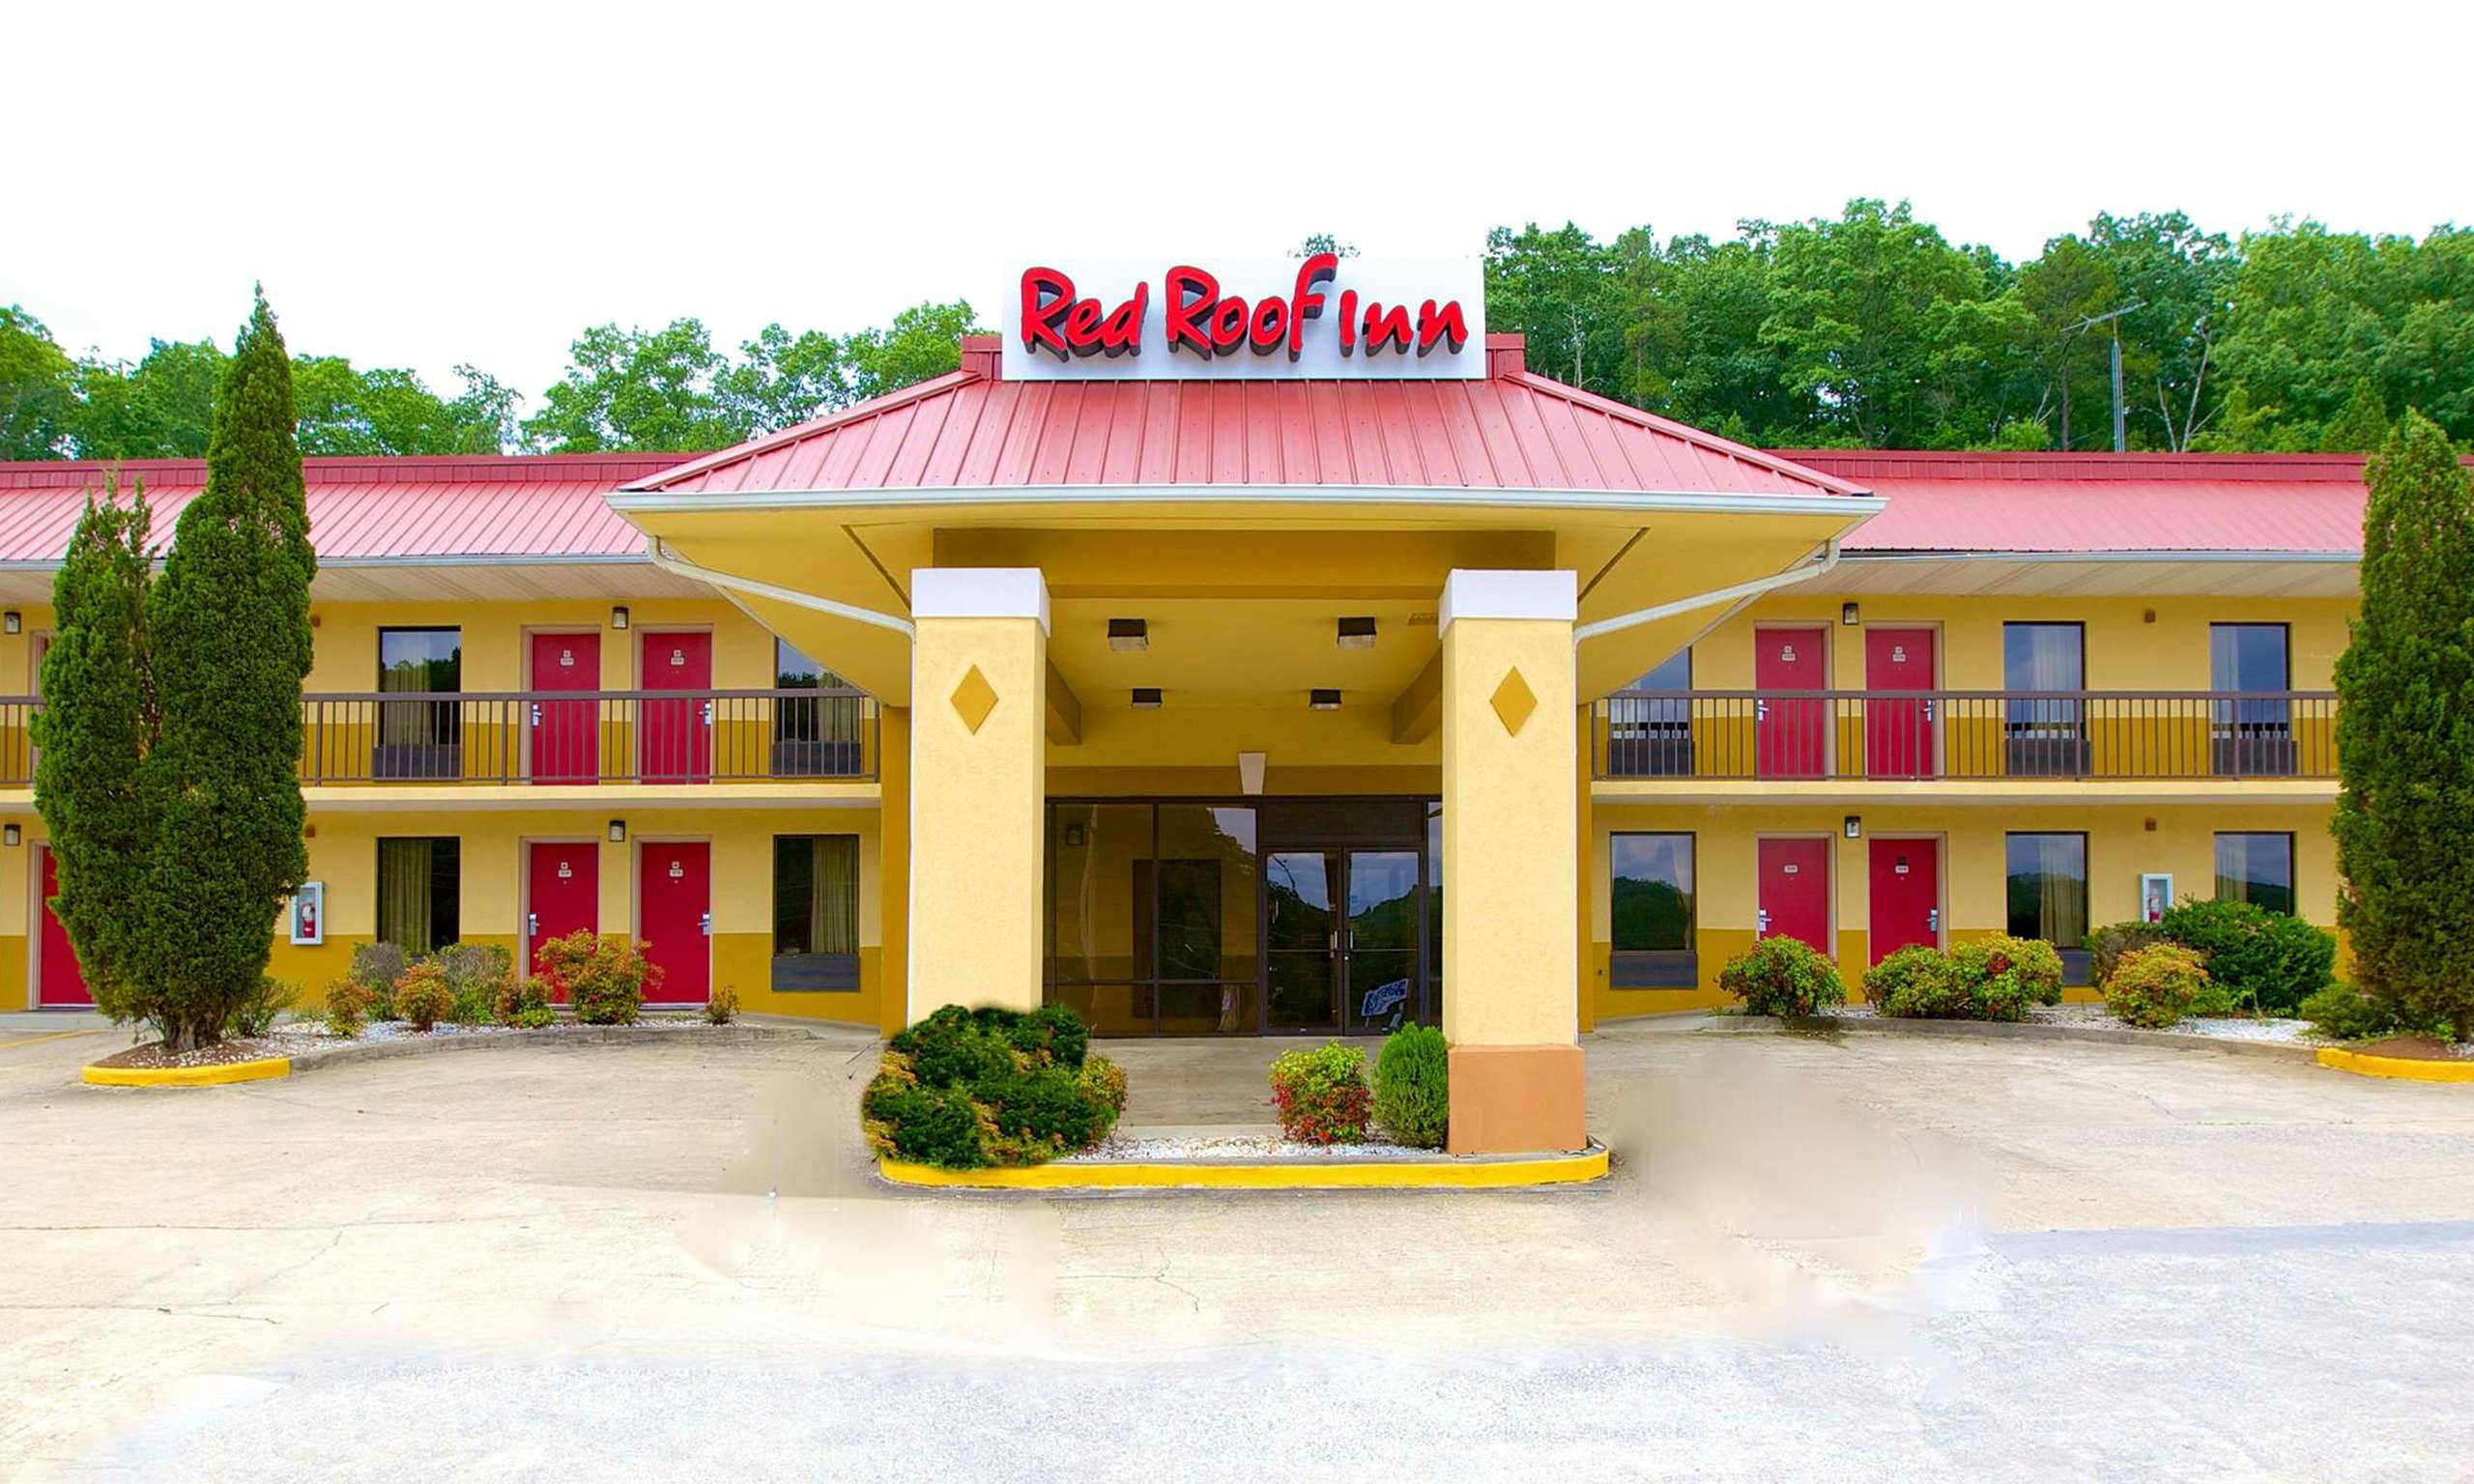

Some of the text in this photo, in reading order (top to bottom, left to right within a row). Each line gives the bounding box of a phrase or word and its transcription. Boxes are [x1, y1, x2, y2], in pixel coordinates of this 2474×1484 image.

[1021, 252, 1469, 362] Red Roof Inn
